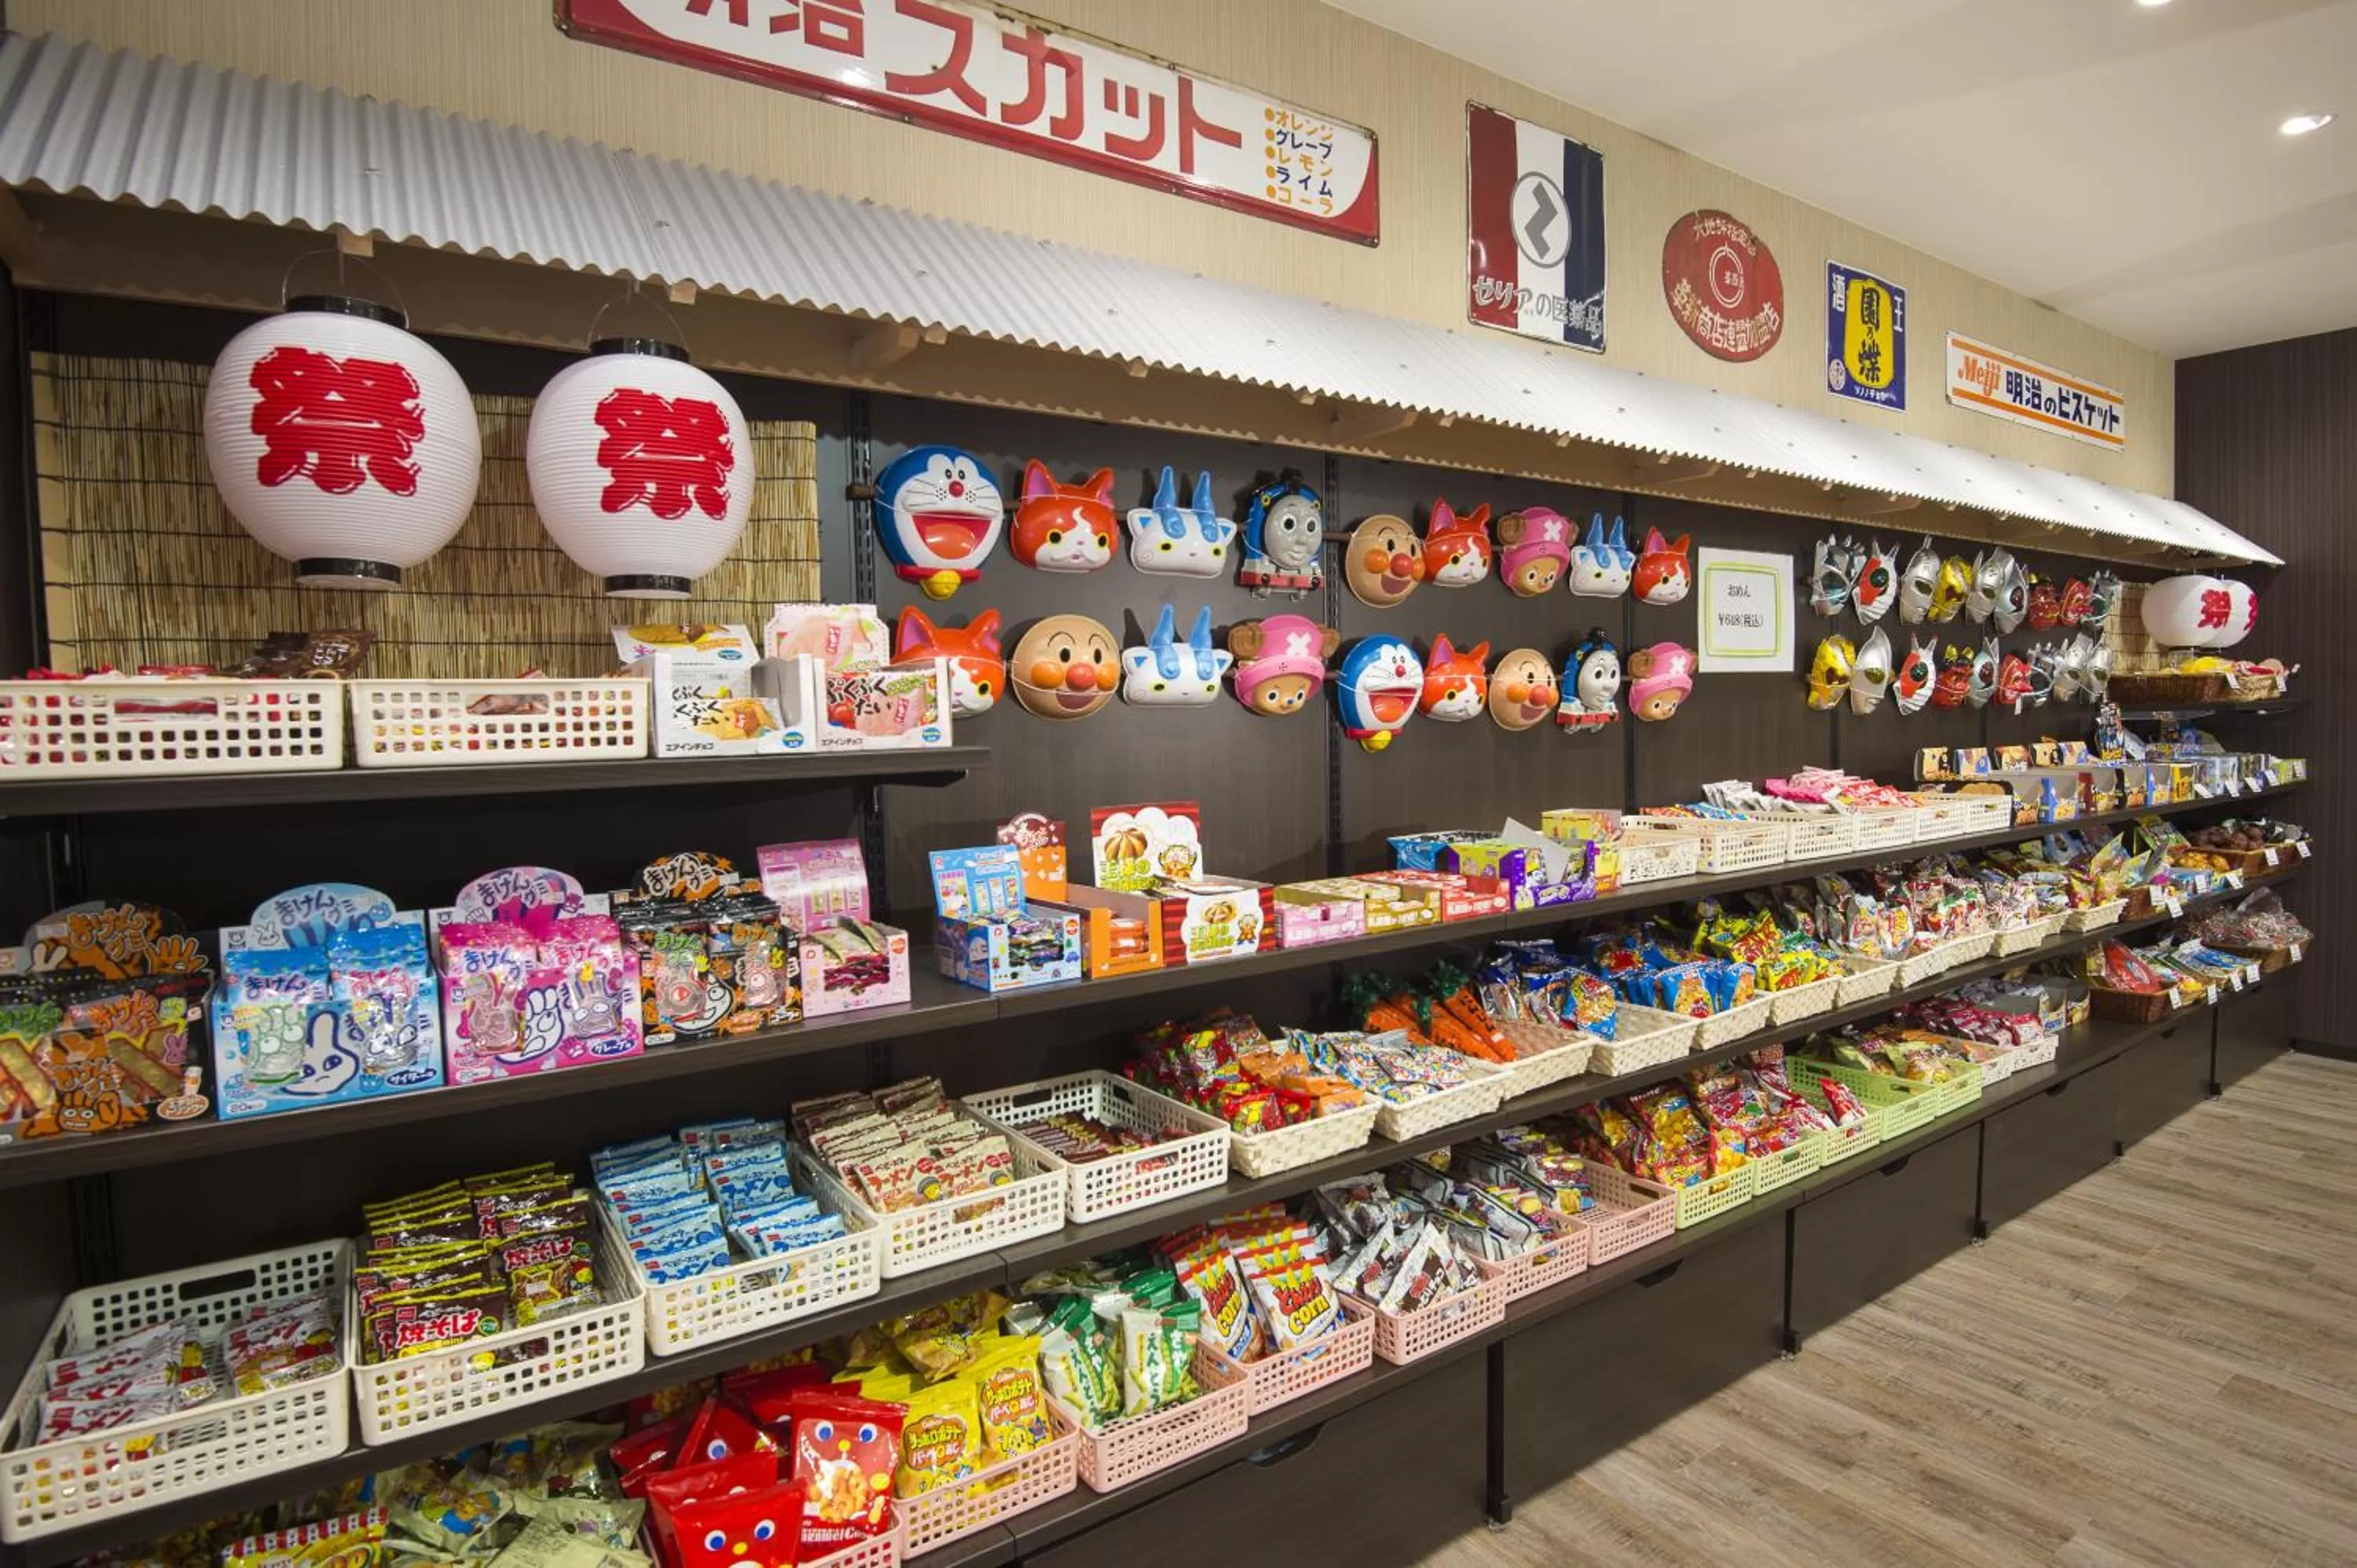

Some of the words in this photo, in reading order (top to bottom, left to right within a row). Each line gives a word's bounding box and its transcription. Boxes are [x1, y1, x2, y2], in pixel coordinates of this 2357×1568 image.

[1276, 110, 1332, 141] オレンジ
[1276, 129, 1332, 159] グレープ
[1278, 148, 1332, 176] レモン
[1276, 166, 1333, 198] ライム
[1277, 186, 1333, 214] コーラ
[1958, 357, 2000, 396] Meiji
[2006, 371, 2120, 432] 明治のビスケット
[249, 346, 425, 497] 祭
[595, 388, 734, 521] 祭
[275, 888, 357, 926] まけんグミ
[477, 873, 549, 907] まけんグミ
[395, 1307, 482, 1348] 焼そば
